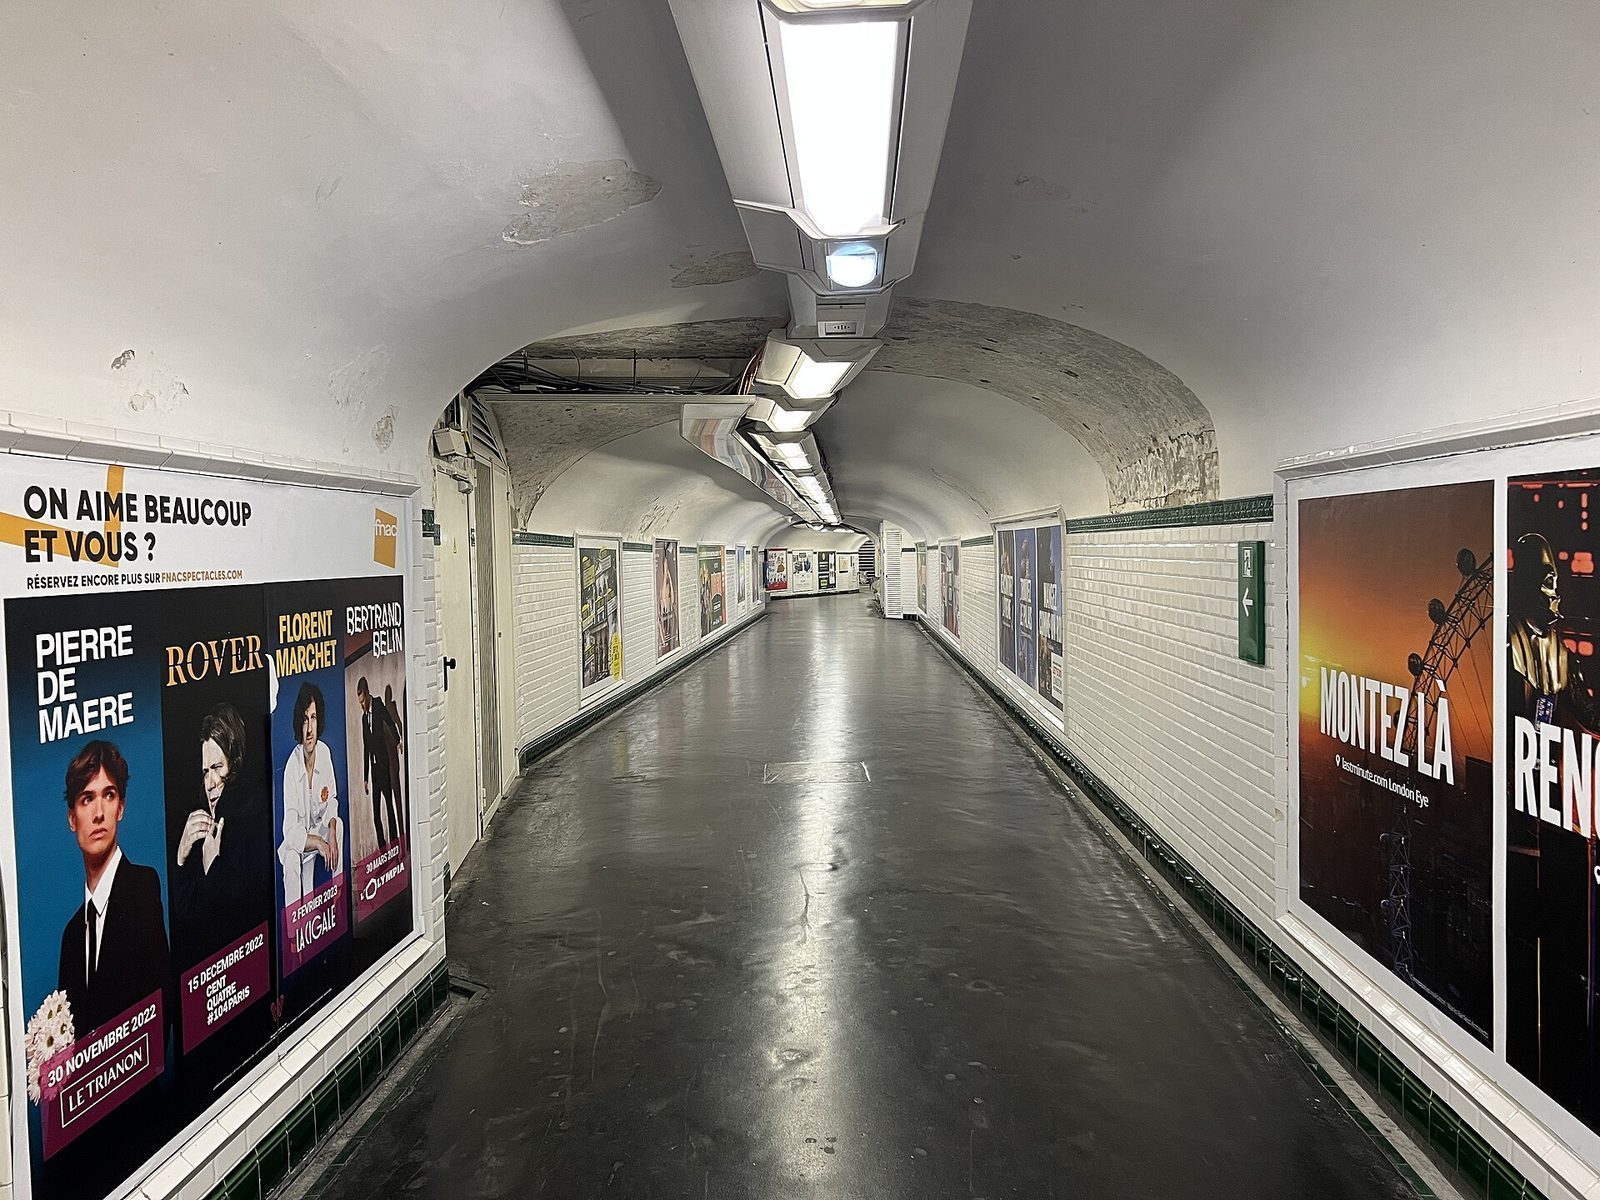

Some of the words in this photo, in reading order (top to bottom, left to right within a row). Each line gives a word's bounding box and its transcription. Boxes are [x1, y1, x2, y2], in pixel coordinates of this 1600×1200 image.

[23, 485, 68, 520] ON
[76, 490, 138, 523] AIME
[145, 494, 252, 526] BEAUCOUP
[25, 530, 57, 563] ET
[65, 530, 138, 562] VOUS
[144, 532, 156, 561] ?
[375, 519, 398, 537] fnac
[27, 574, 79, 590] RÉSERVEZ
[81, 574, 119, 586] ENCORE
[121, 573, 143, 585] PLUS
[144, 573, 160, 584] SUR
[161, 569, 243, 583] FNACSPECTACLES.COM
[279, 610, 333, 644] FLORENT
[346, 602, 402, 636] BERTRAND
[36, 624, 133, 668] PIERRE
[166, 635, 263, 687] ROVER
[276, 639, 337, 678] MARCHET
[373, 627, 403, 658] BELIN
[37, 667, 76, 706] DE
[39, 692, 134, 744] MAERE
[1320, 667, 1409, 768] MONTEZ
[1416, 679, 1455, 786] LÀ
[1341, 757, 1388, 789] lastminute.com
[1388, 778, 1414, 802] London
[1415, 790, 1429, 809] Eye
[365, 863, 373, 874] 30
[373, 853, 387, 870] MARS
[388, 845, 399, 860] 2023
[291, 911, 297, 923] 2
[297, 895, 323, 920] FEVRIER
[323, 884, 338, 902] 2023
[188, 975, 199, 993] 15
[200, 945, 245, 985] DECEMBRE
[245, 933, 264, 956] 2022
[206, 975, 226, 997] CENT
[206, 982, 236, 1011] QUATRE
[207, 986, 250, 1026] #104PARIS
[47, 1065, 64, 1088] 30
[65, 1021, 131, 1077] NOVEMBRE
[131, 1004, 156, 1033] 2022
[69, 1087, 85, 1112] LE
[85, 1046, 142, 1098] TRIANON
